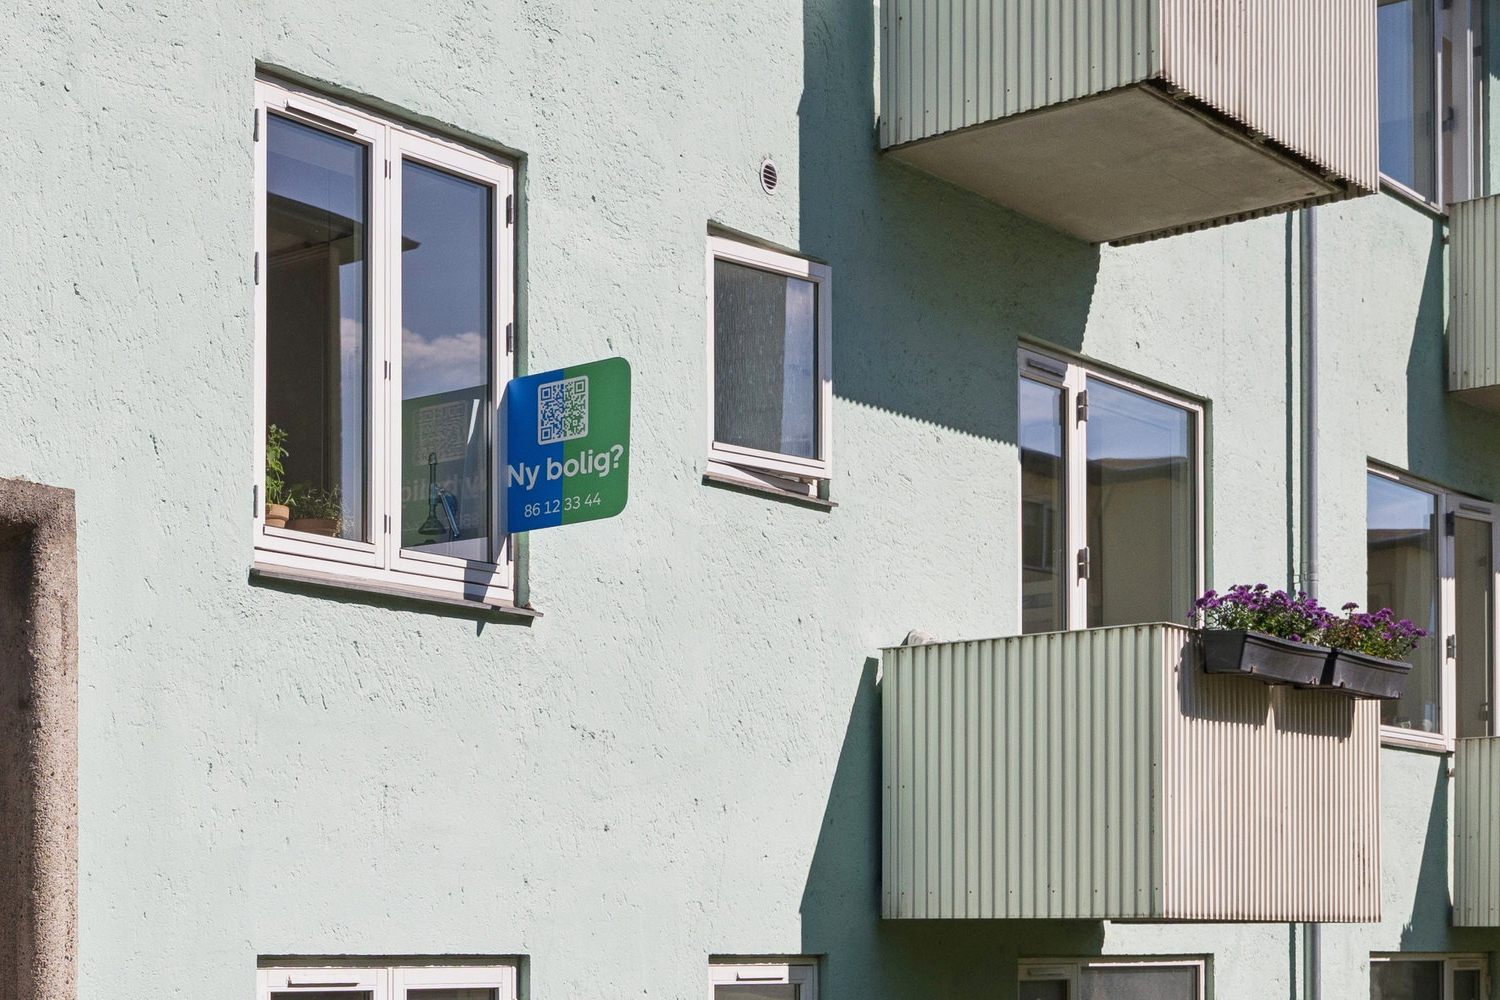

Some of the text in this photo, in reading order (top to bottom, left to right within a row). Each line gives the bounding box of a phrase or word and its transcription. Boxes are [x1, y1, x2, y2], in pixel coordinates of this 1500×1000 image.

[507, 444, 624, 490] Ny bolig?
[524, 492, 602, 518] 86 12 33 44
